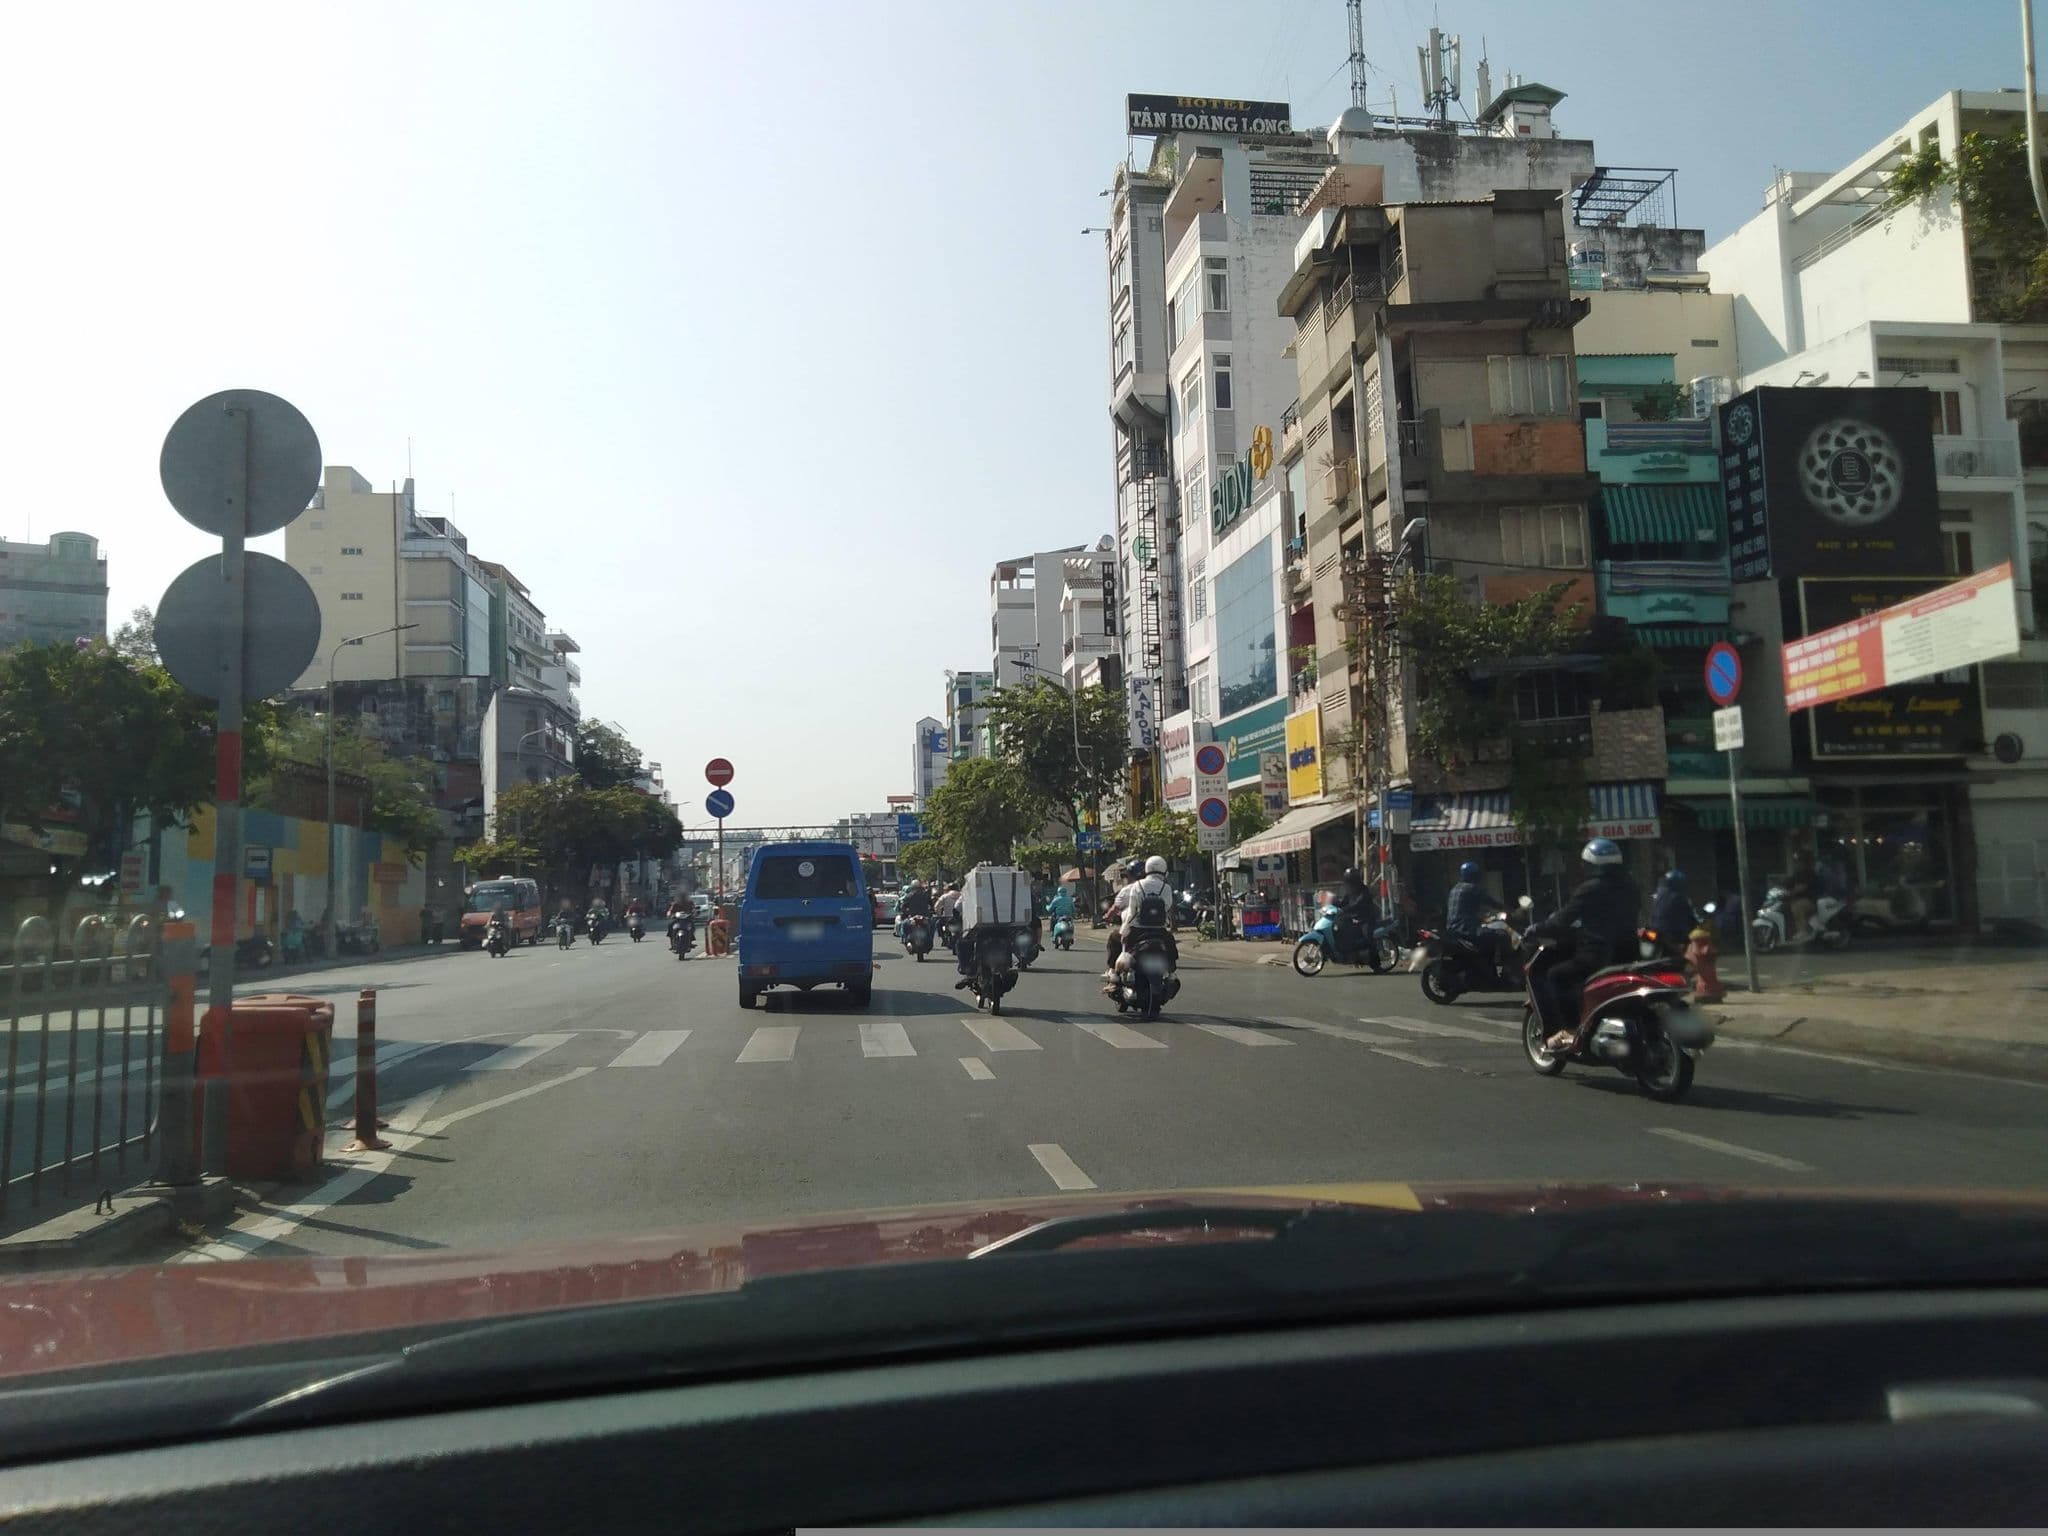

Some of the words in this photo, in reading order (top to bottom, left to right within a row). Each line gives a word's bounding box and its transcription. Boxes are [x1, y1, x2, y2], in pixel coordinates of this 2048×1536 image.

[1131, 106, 1166, 128] TÂN
[1170, 109, 1238, 133] HOÀNG
[1241, 116, 1292, 136] LONG
[1177, 96, 1251, 111] HOTEL
[1211, 448, 1252, 535] BIDV
[1104, 563, 1114, 636] HOTEL
